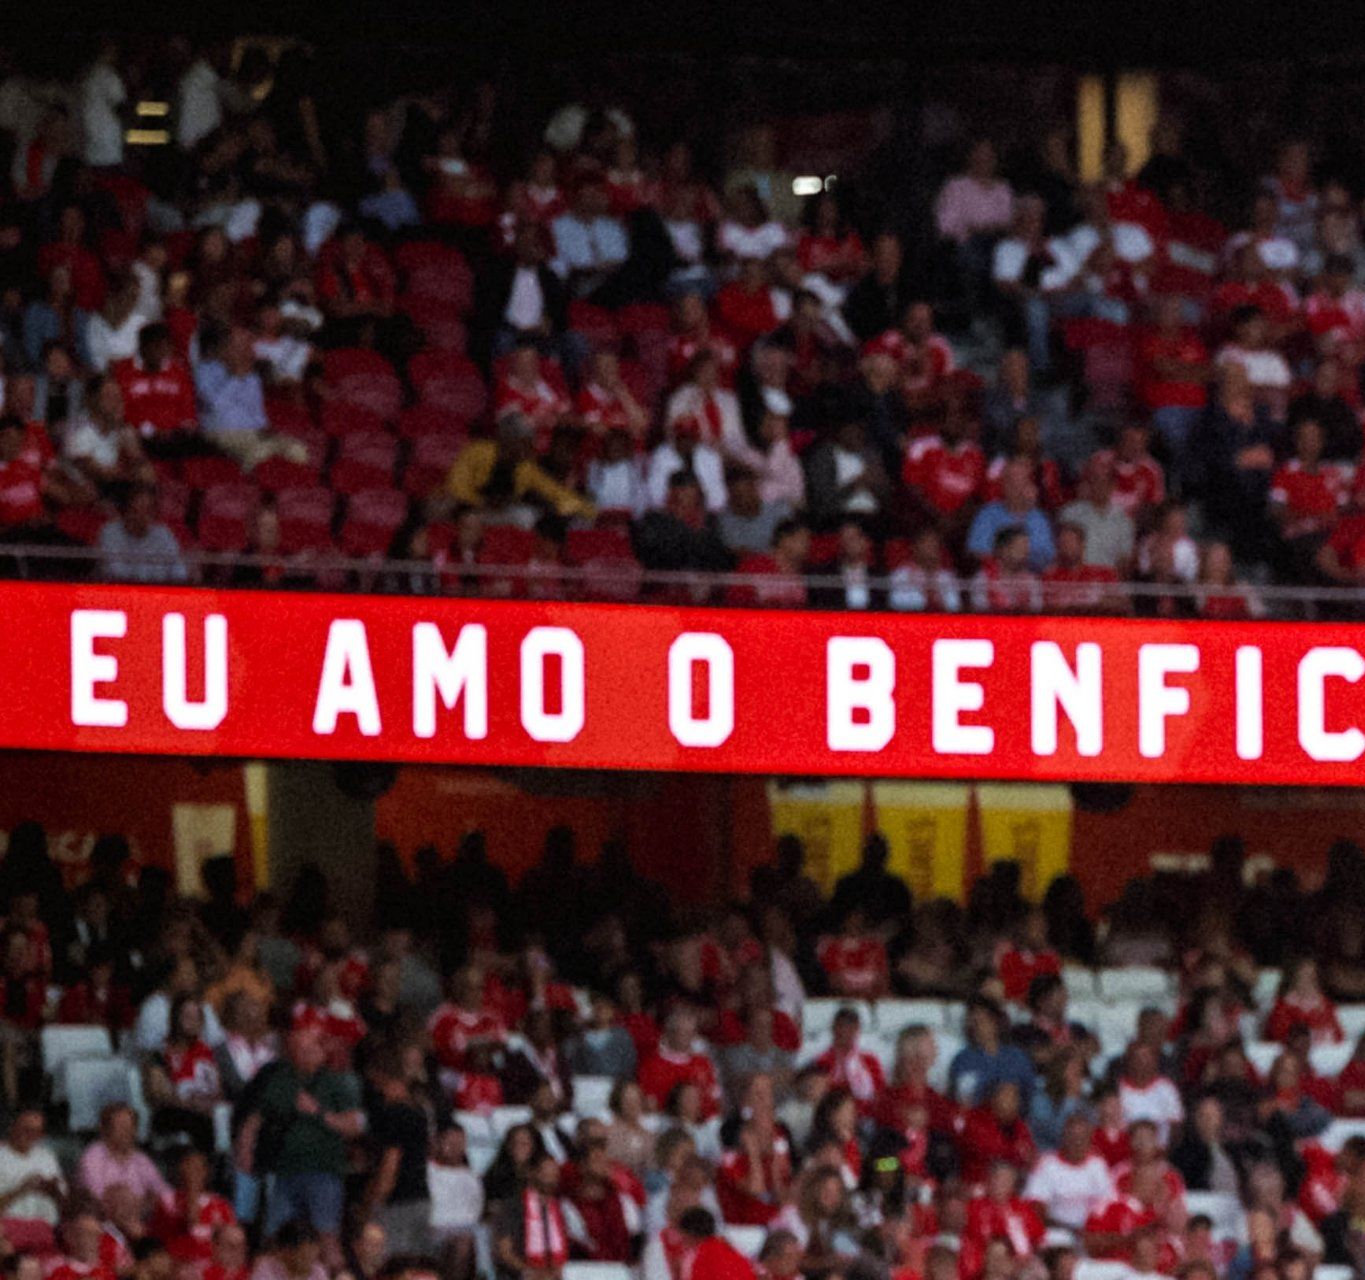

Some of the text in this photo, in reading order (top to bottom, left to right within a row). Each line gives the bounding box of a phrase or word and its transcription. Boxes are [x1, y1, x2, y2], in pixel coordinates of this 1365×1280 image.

[70, 609, 228, 730] EU
[313, 618, 585, 742] AMO
[668, 631, 734, 747] O
